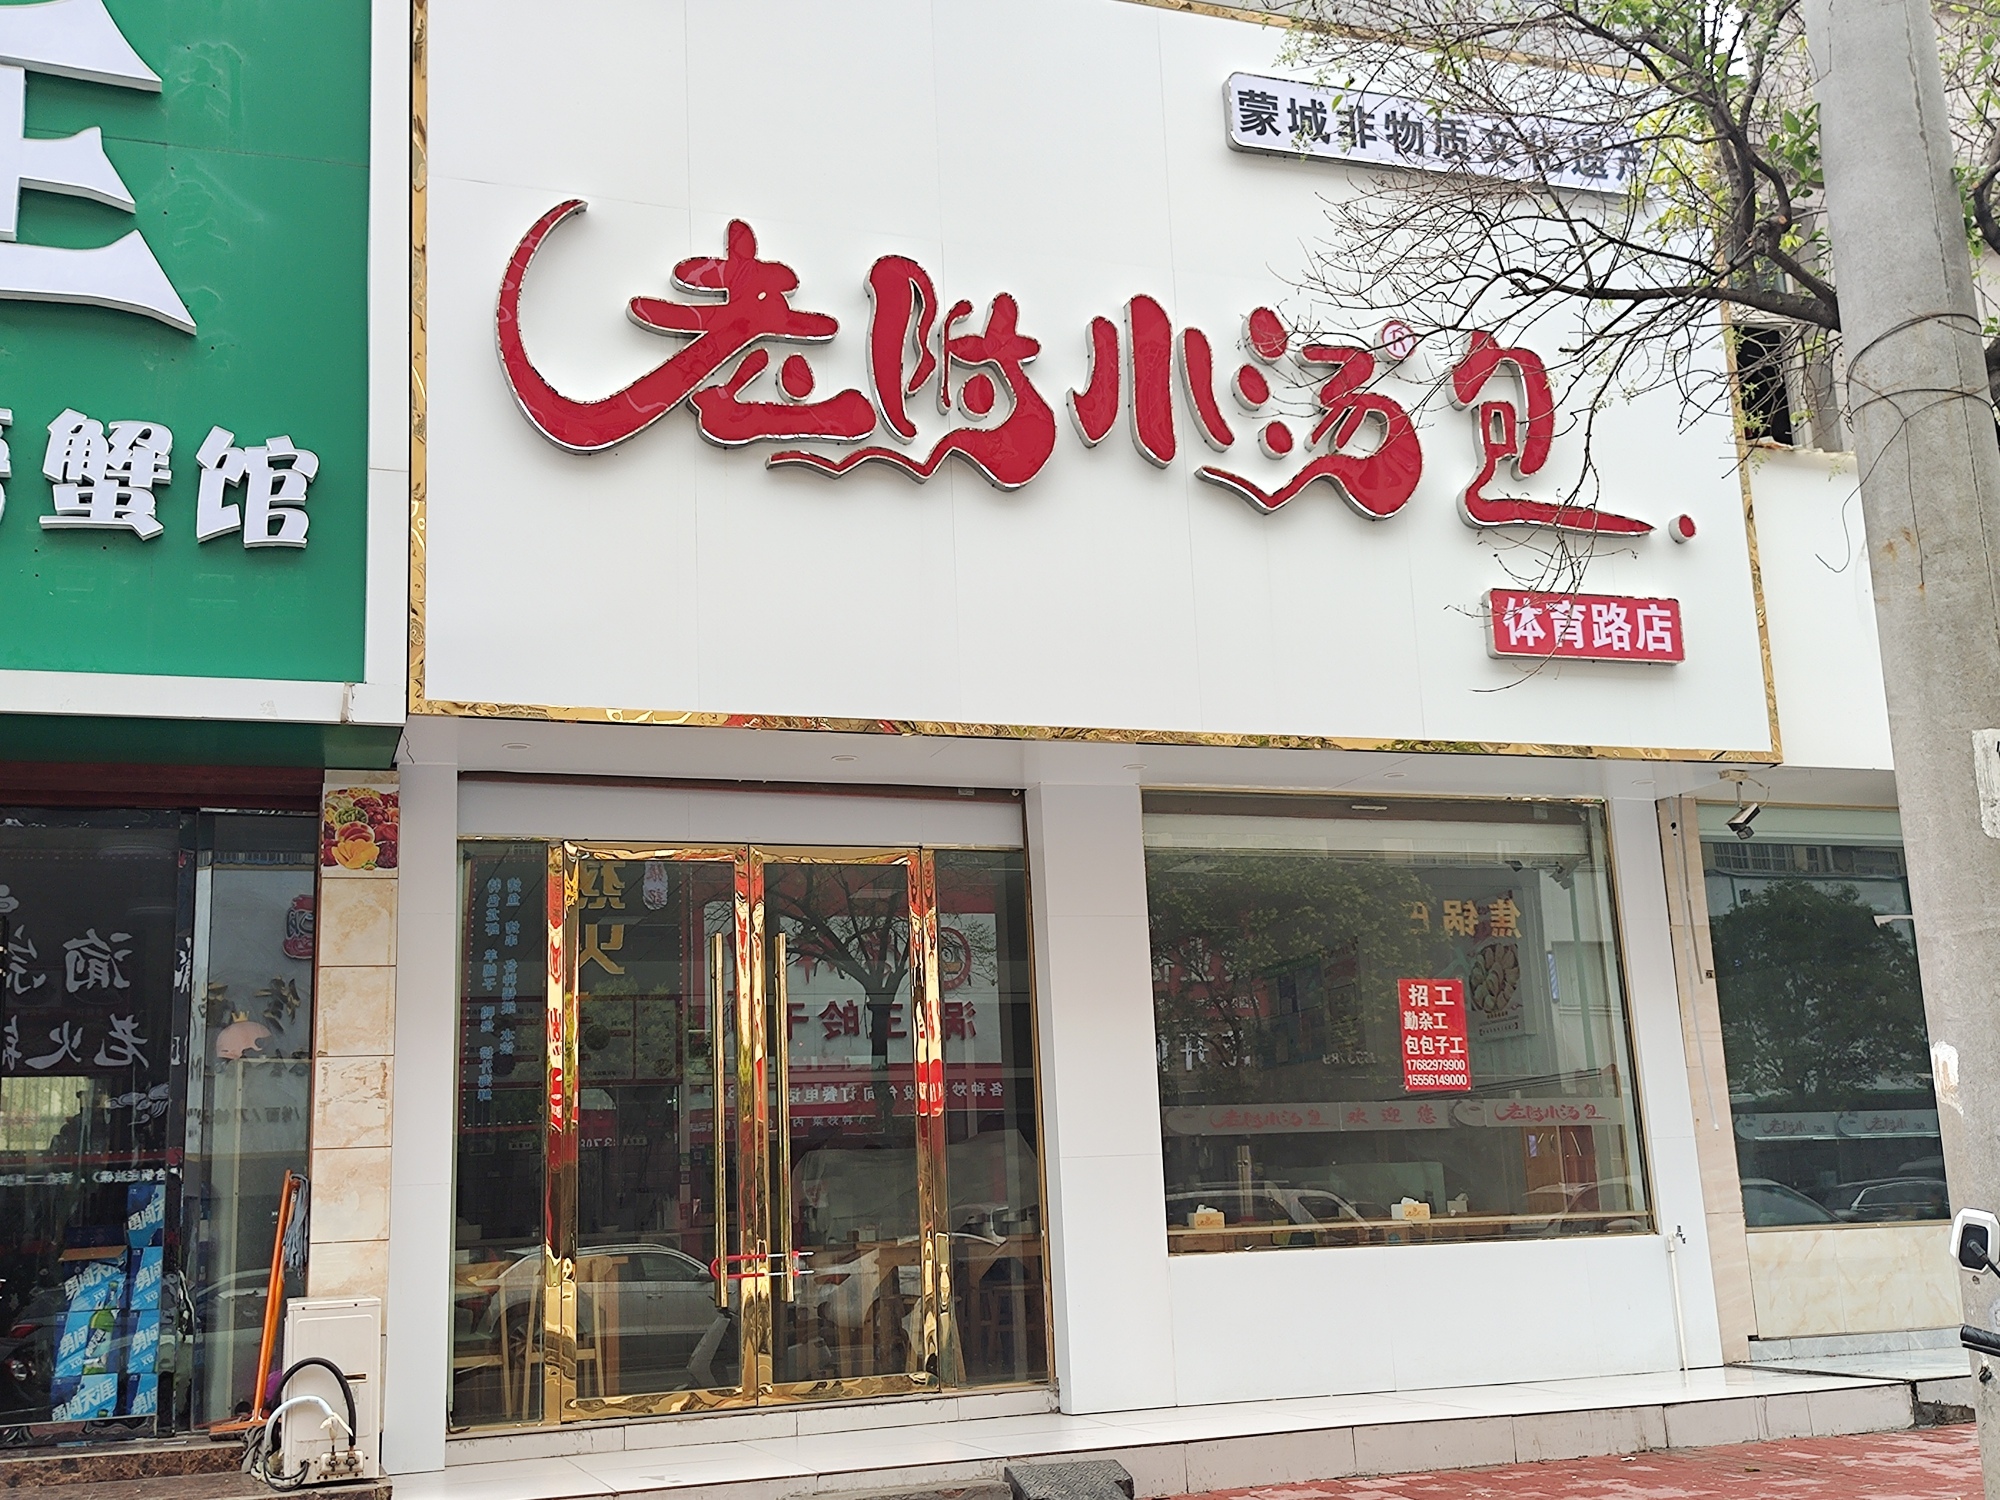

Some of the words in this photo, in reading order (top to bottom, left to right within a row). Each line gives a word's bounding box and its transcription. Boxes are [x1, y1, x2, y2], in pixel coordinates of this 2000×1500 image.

[0, 408, 319, 548] 蟹馆
[1502, 596, 1674, 653] 体育路店
[1408, 983, 1455, 1007] 招工
[1403, 1010, 1449, 1031] 勤杂工
[1404, 1034, 1466, 1055] 包包子工
[1406, 1058, 1466, 1071] 17682979900
[1407, 1073, 1468, 1086] 15556149000
